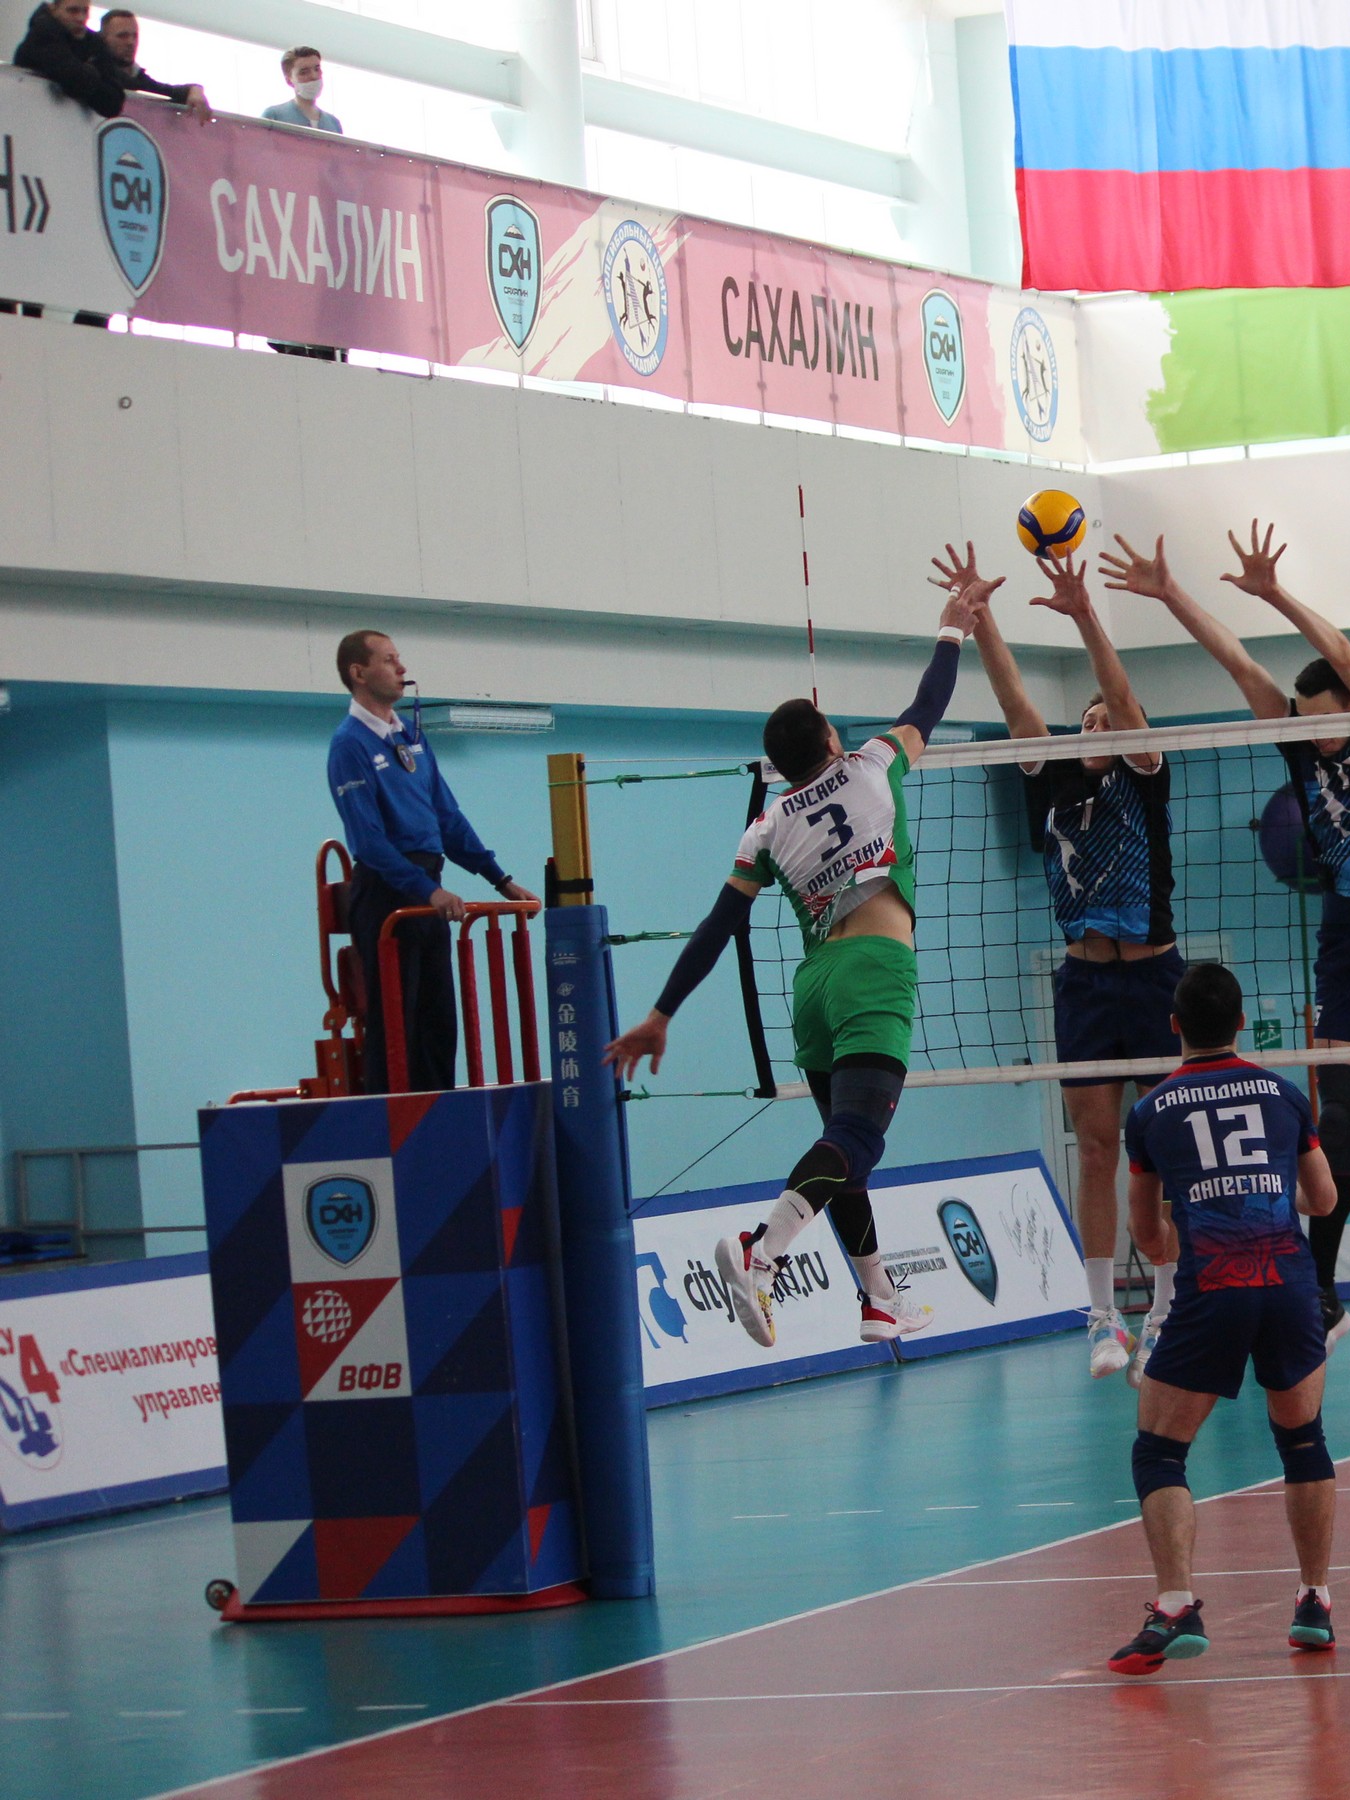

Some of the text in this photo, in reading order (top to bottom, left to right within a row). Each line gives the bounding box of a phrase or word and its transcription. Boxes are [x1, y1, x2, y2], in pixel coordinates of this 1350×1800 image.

[210, 178, 425, 303] САХАЛИН
[603, 224, 668, 316] ВОЛЕЙБОЛЬНЫЙ ЦЕНТР
[623, 343, 660, 374] САХАЛИН
[721, 276, 880, 382] САХАЛИН
[805, 802, 854, 863] 3
[807, 837, 885, 895] ДАГЕСТАН
[557, 1003, 580, 1108] 金陵体育
[1154, 1079, 1281, 1113] САЙПОДИНОВ
[1183, 1103, 1269, 1171] 12
[1188, 1174, 1283, 1203] ДАГЕСТАН
[18, 1334, 61, 1404] 4
[60, 1336, 218, 1377] «Специализиров
[337, 1362, 403, 1392] ВФВ
